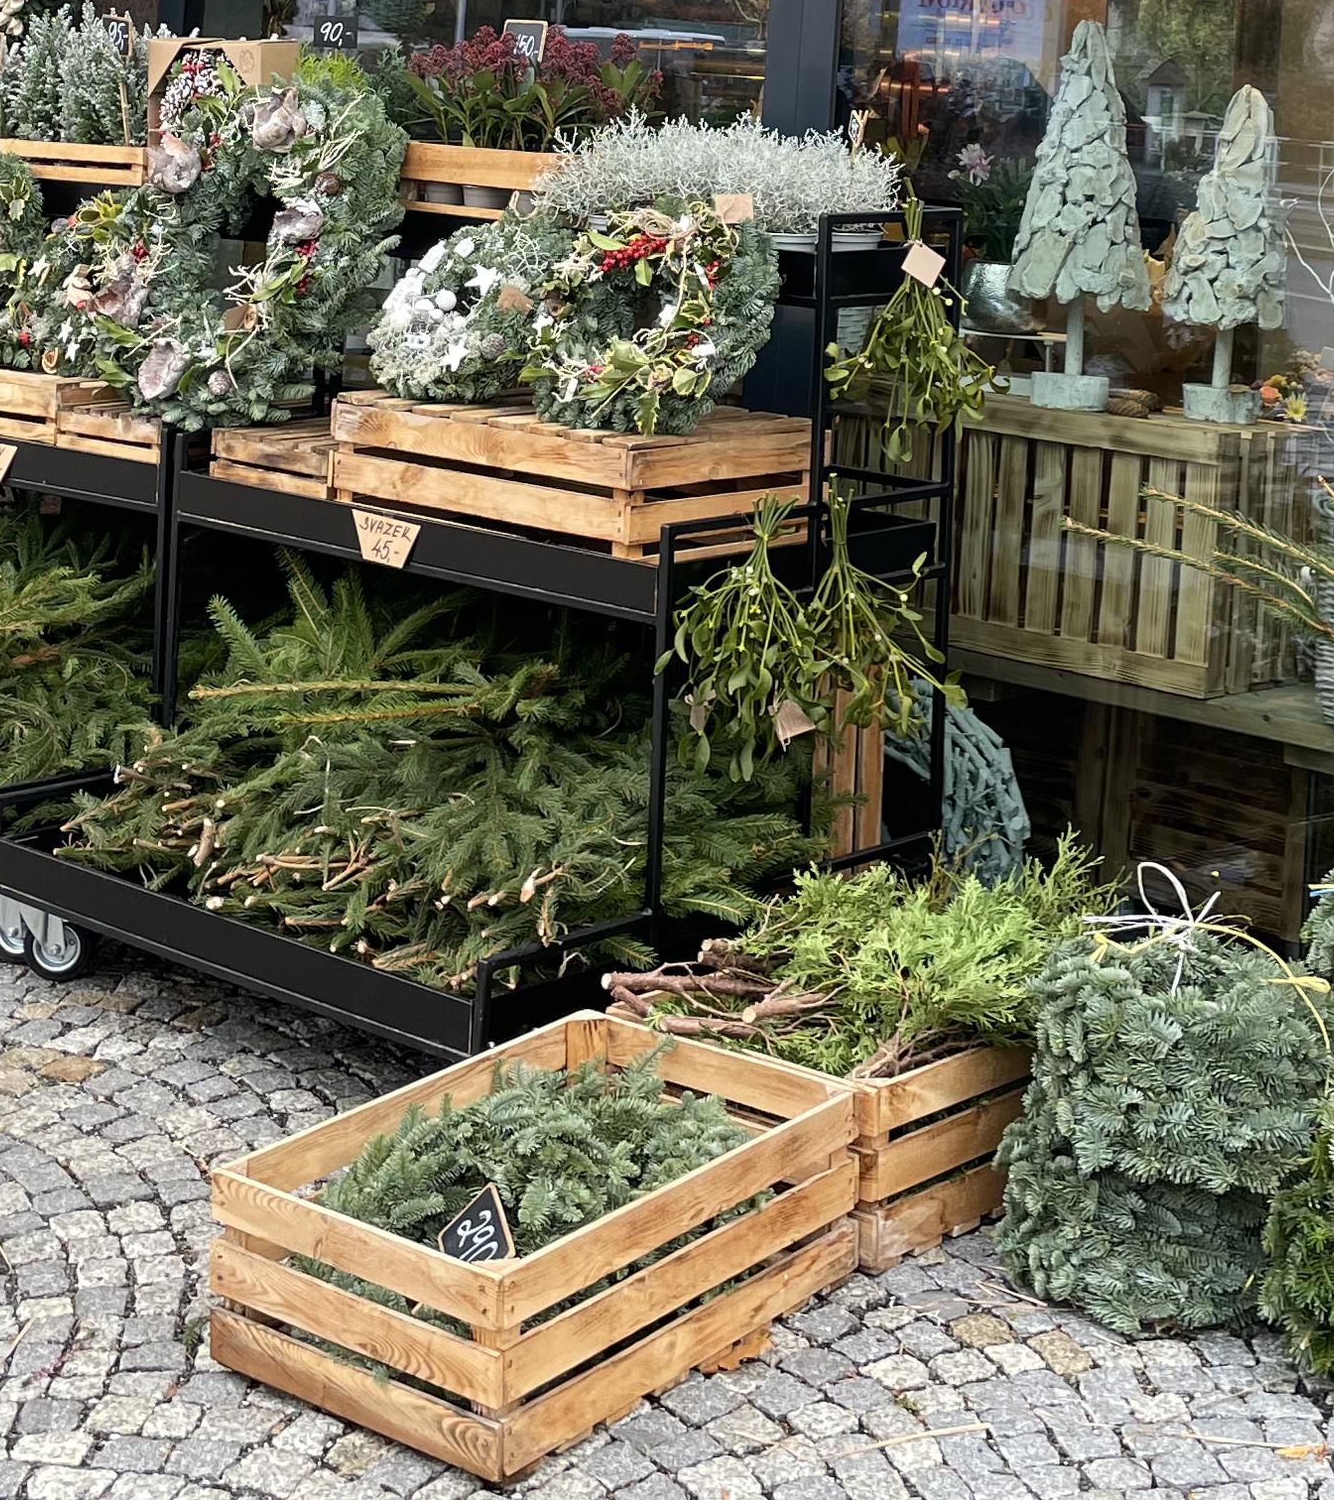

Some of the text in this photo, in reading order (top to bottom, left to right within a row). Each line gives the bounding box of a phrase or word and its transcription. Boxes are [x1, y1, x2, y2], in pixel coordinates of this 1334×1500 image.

[320, 21, 355, 47] 90,-
[358, 516, 412, 543] SVAZEK
[370, 538, 400, 564] 45,-
